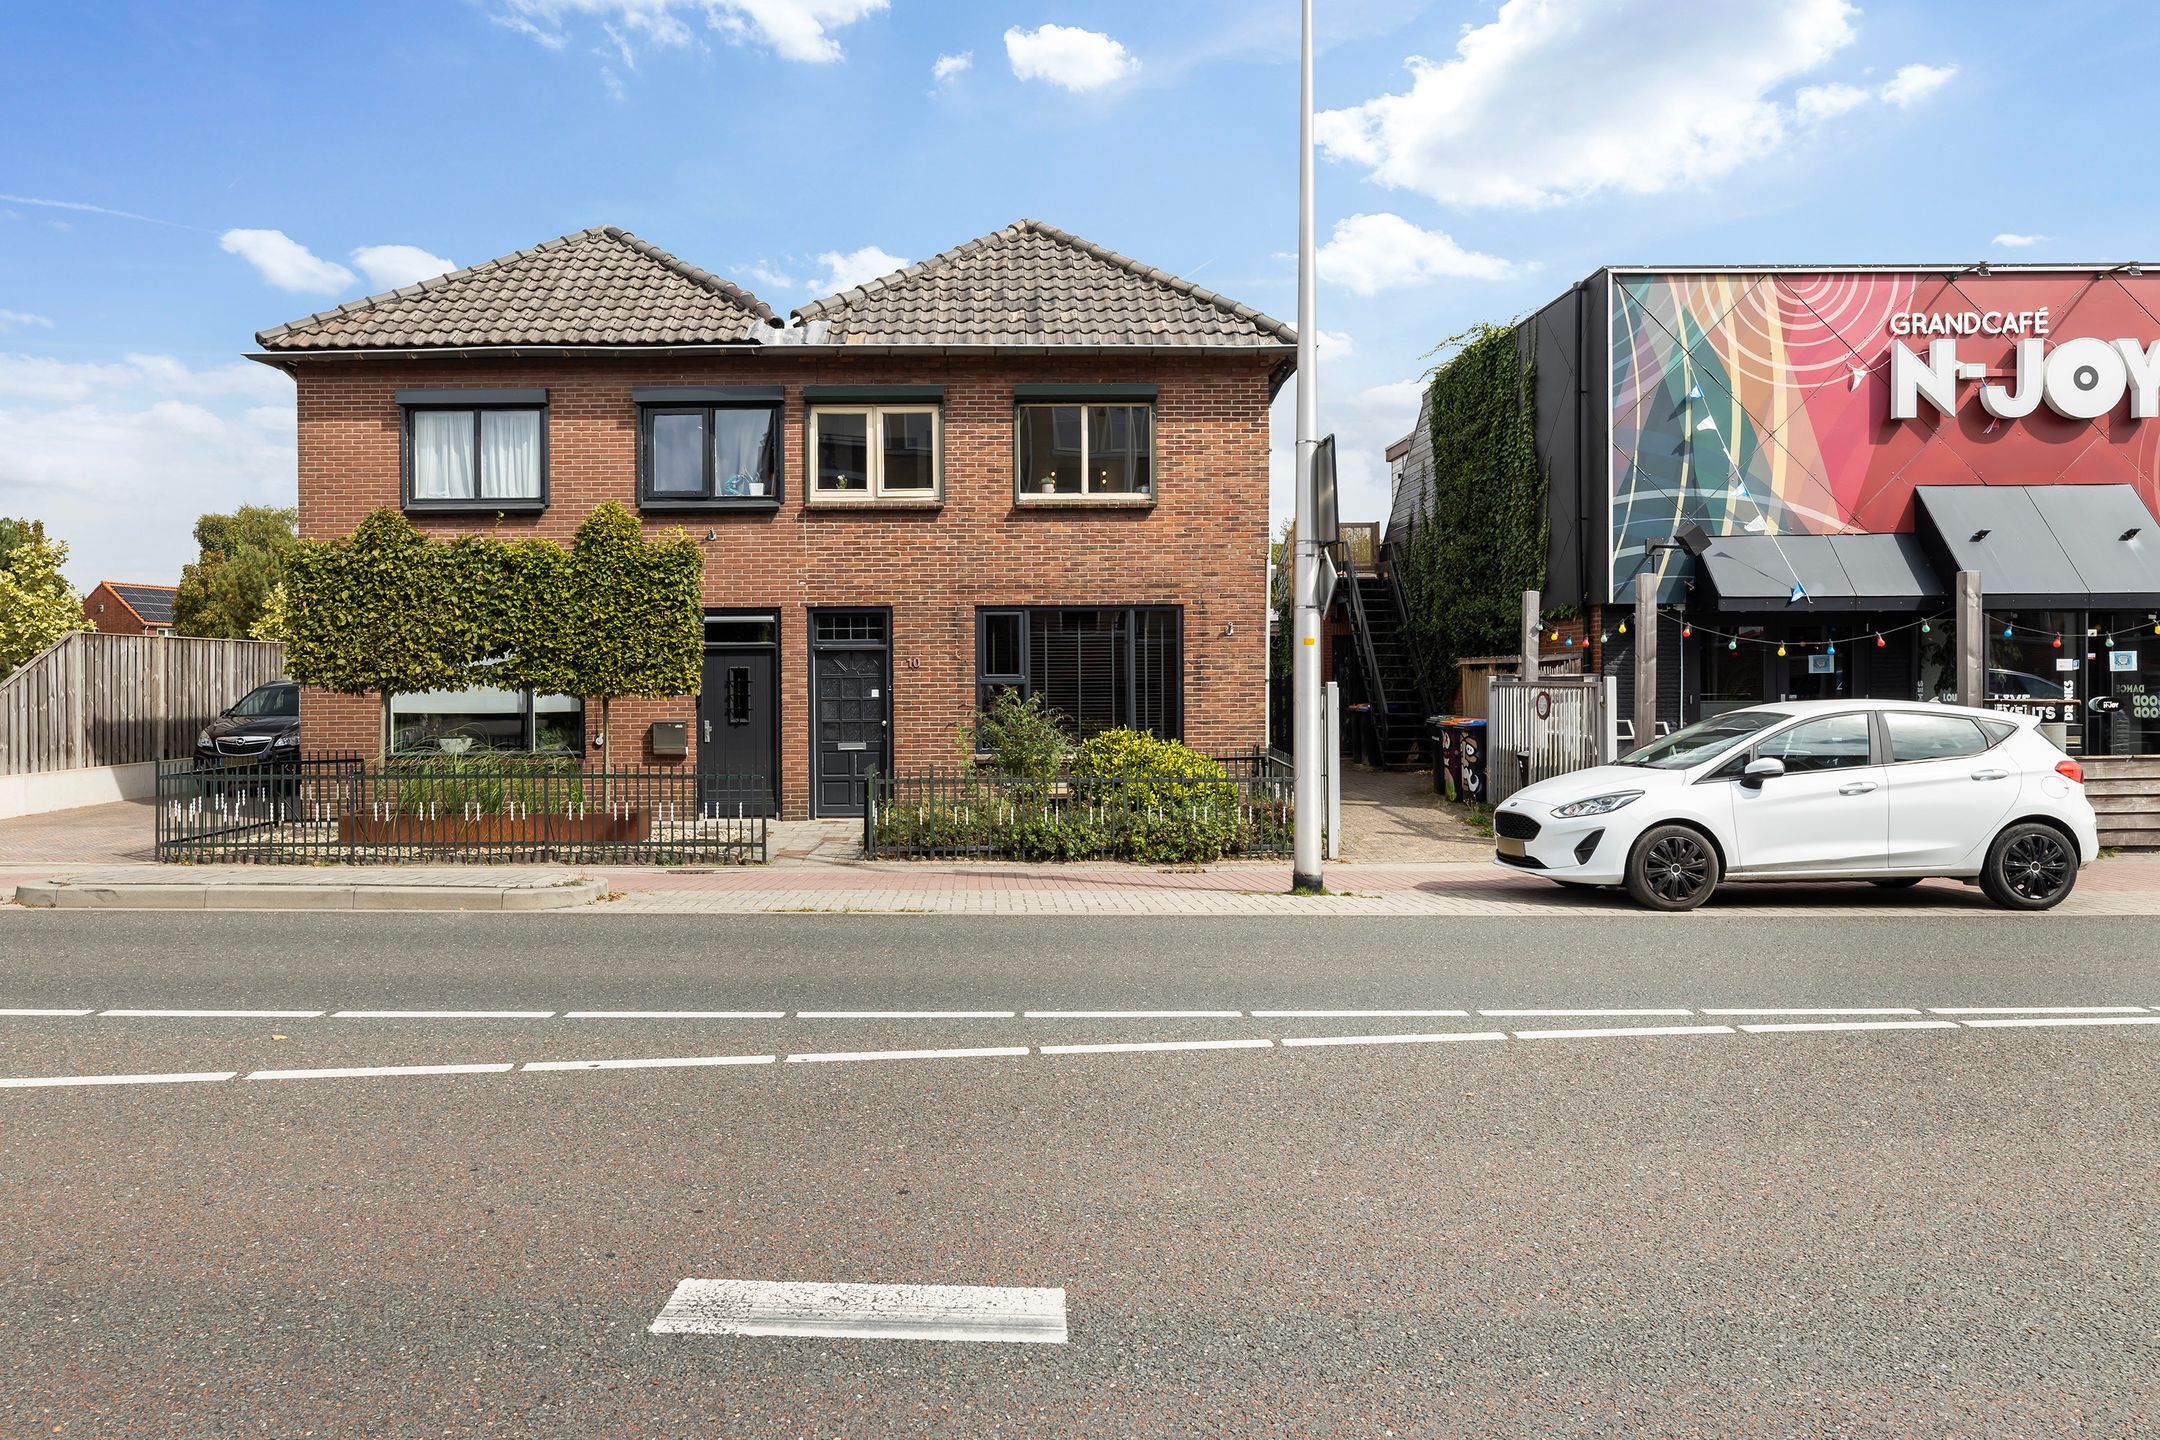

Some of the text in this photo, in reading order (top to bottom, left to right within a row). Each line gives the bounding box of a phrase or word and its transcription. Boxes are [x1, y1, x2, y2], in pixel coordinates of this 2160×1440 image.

[1890, 307, 2050, 335] GRANDCAFÉ
[1891, 337, 2160, 420] N-JOY
[907, 657, 920, 668] 10
[2064, 680, 2073, 720] DRNKS
